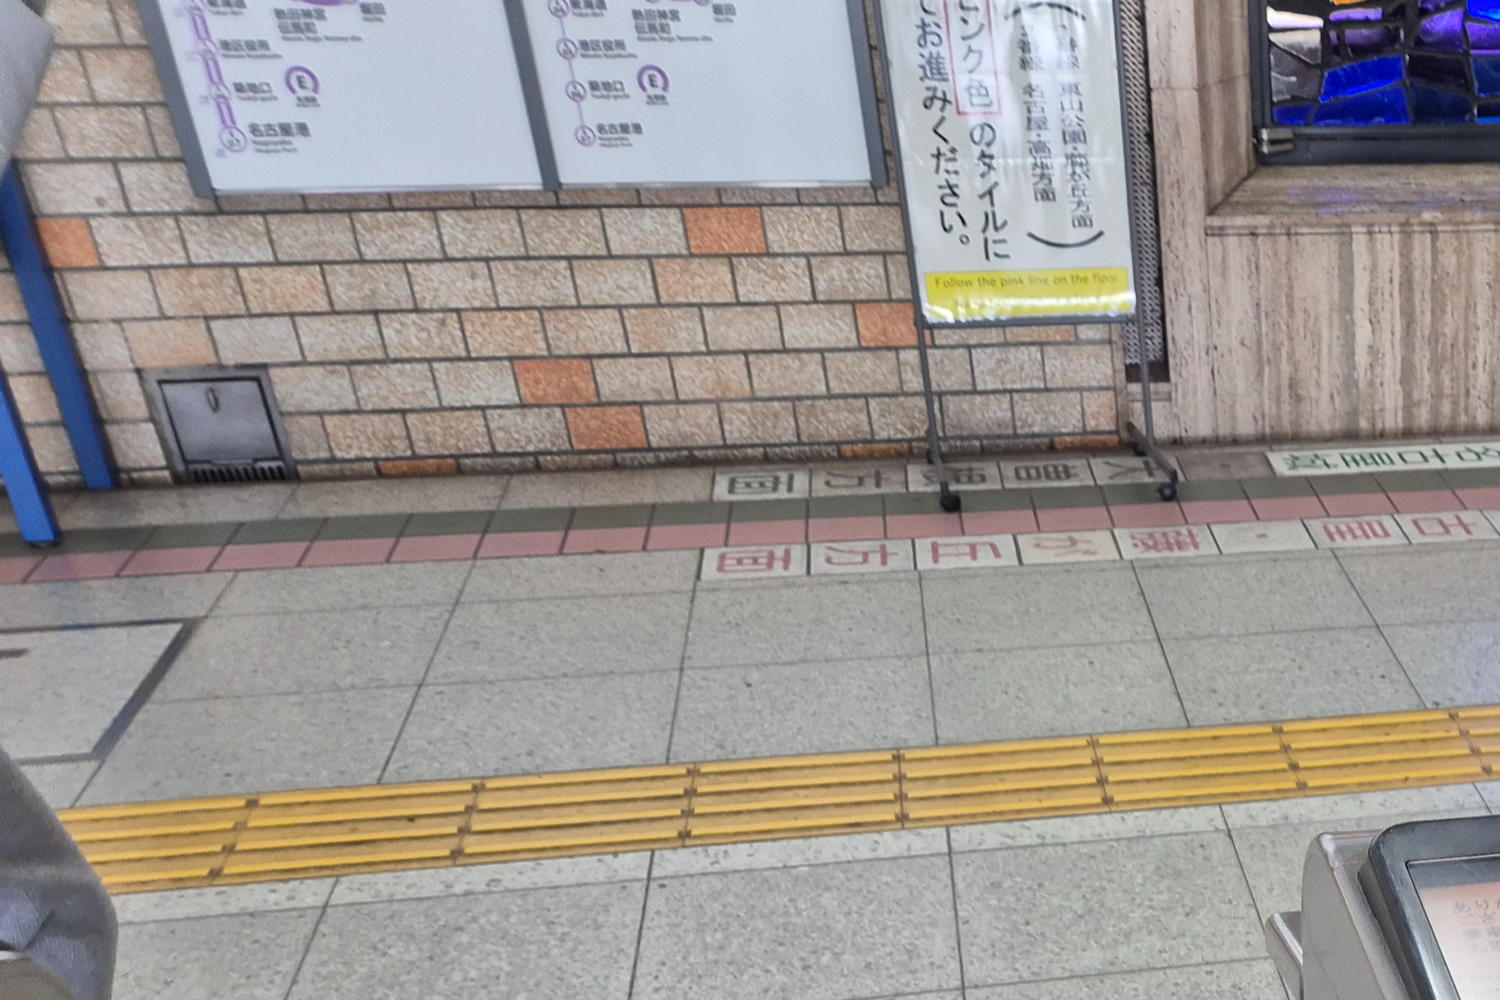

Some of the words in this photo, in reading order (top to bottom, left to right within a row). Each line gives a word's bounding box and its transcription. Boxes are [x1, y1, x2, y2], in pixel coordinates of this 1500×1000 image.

[296, 75, 308, 90] E
[648, 73, 659, 88] E
[935, 276, 974, 289] Follow
[977, 275, 996, 287] the
[1000, 275, 1024, 288] pink
[1028, 273, 1050, 285] line
[1053, 275, 1068, 285] on
[1071, 273, 1089, 284] the
[1092, 272, 1118, 283] floor
